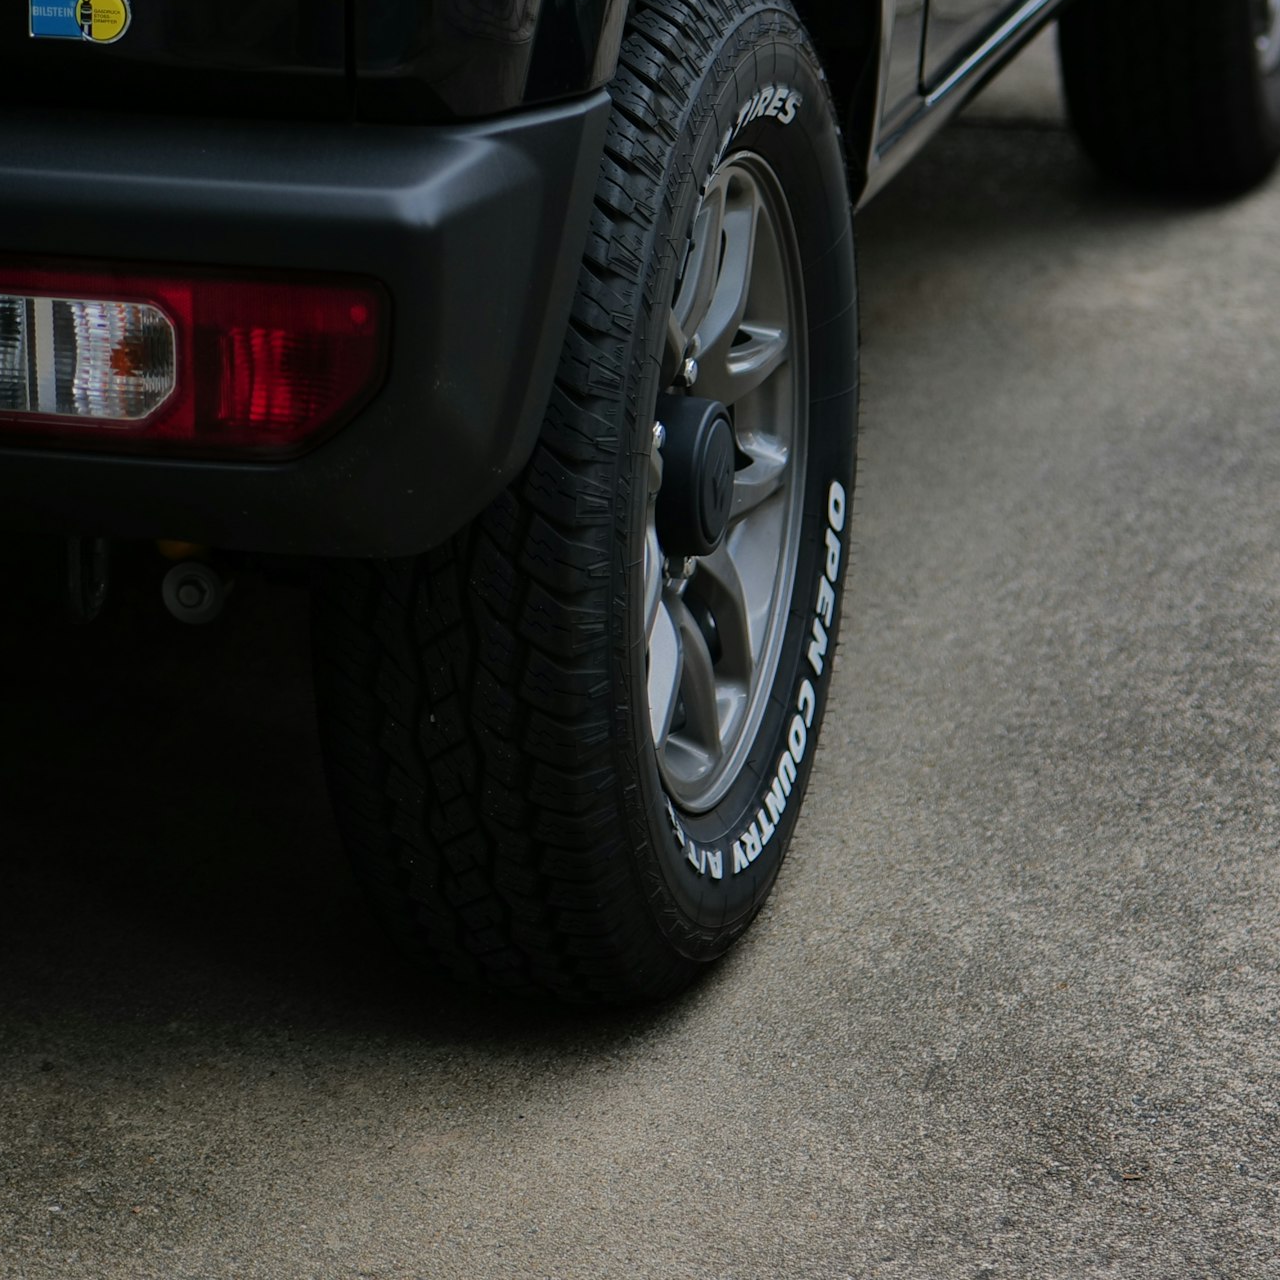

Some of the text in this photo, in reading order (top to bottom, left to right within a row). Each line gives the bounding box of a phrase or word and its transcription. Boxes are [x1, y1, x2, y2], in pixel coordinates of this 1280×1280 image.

[32, 6, 74, 18] BILSTEIN
[732, 83, 803, 139] TIRES
[807, 480, 847, 677] OPEN
[732, 677, 816, 875] COUNTRY
[687, 840, 724, 881] A/T
